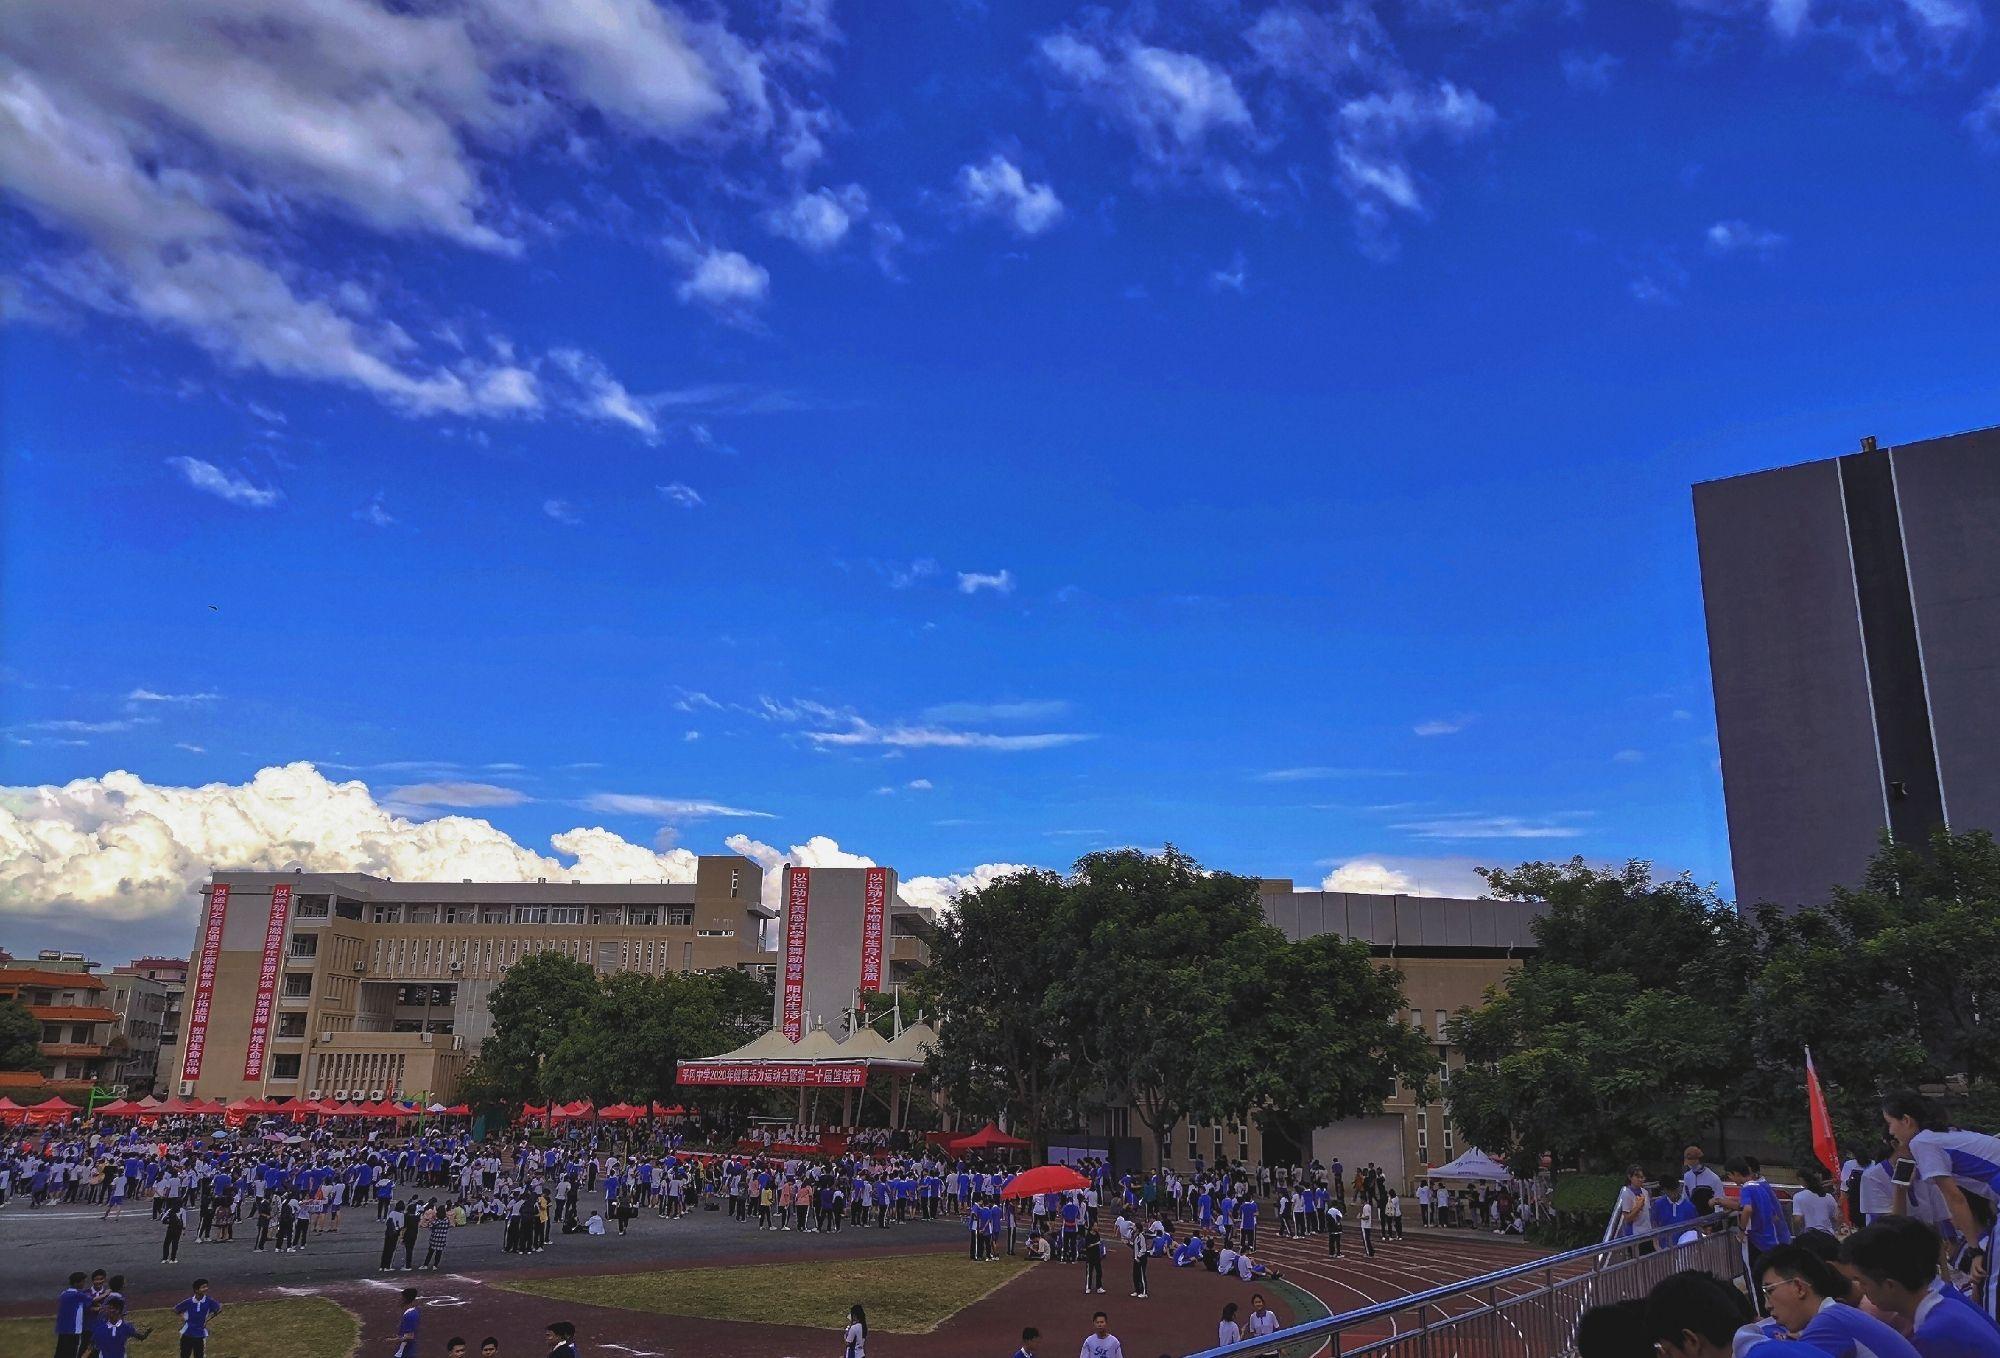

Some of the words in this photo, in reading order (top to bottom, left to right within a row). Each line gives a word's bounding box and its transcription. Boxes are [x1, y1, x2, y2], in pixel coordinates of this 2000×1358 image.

[863, 873, 883, 981] 以运动之本增强学生身心素质
[194, 992, 211, 1023] 开拓进取
[254, 993, 271, 1024] 顽强拼搏
[785, 985, 801, 1019] 阳光生活
[185, 1027, 205, 1074] 塑造生命品格
